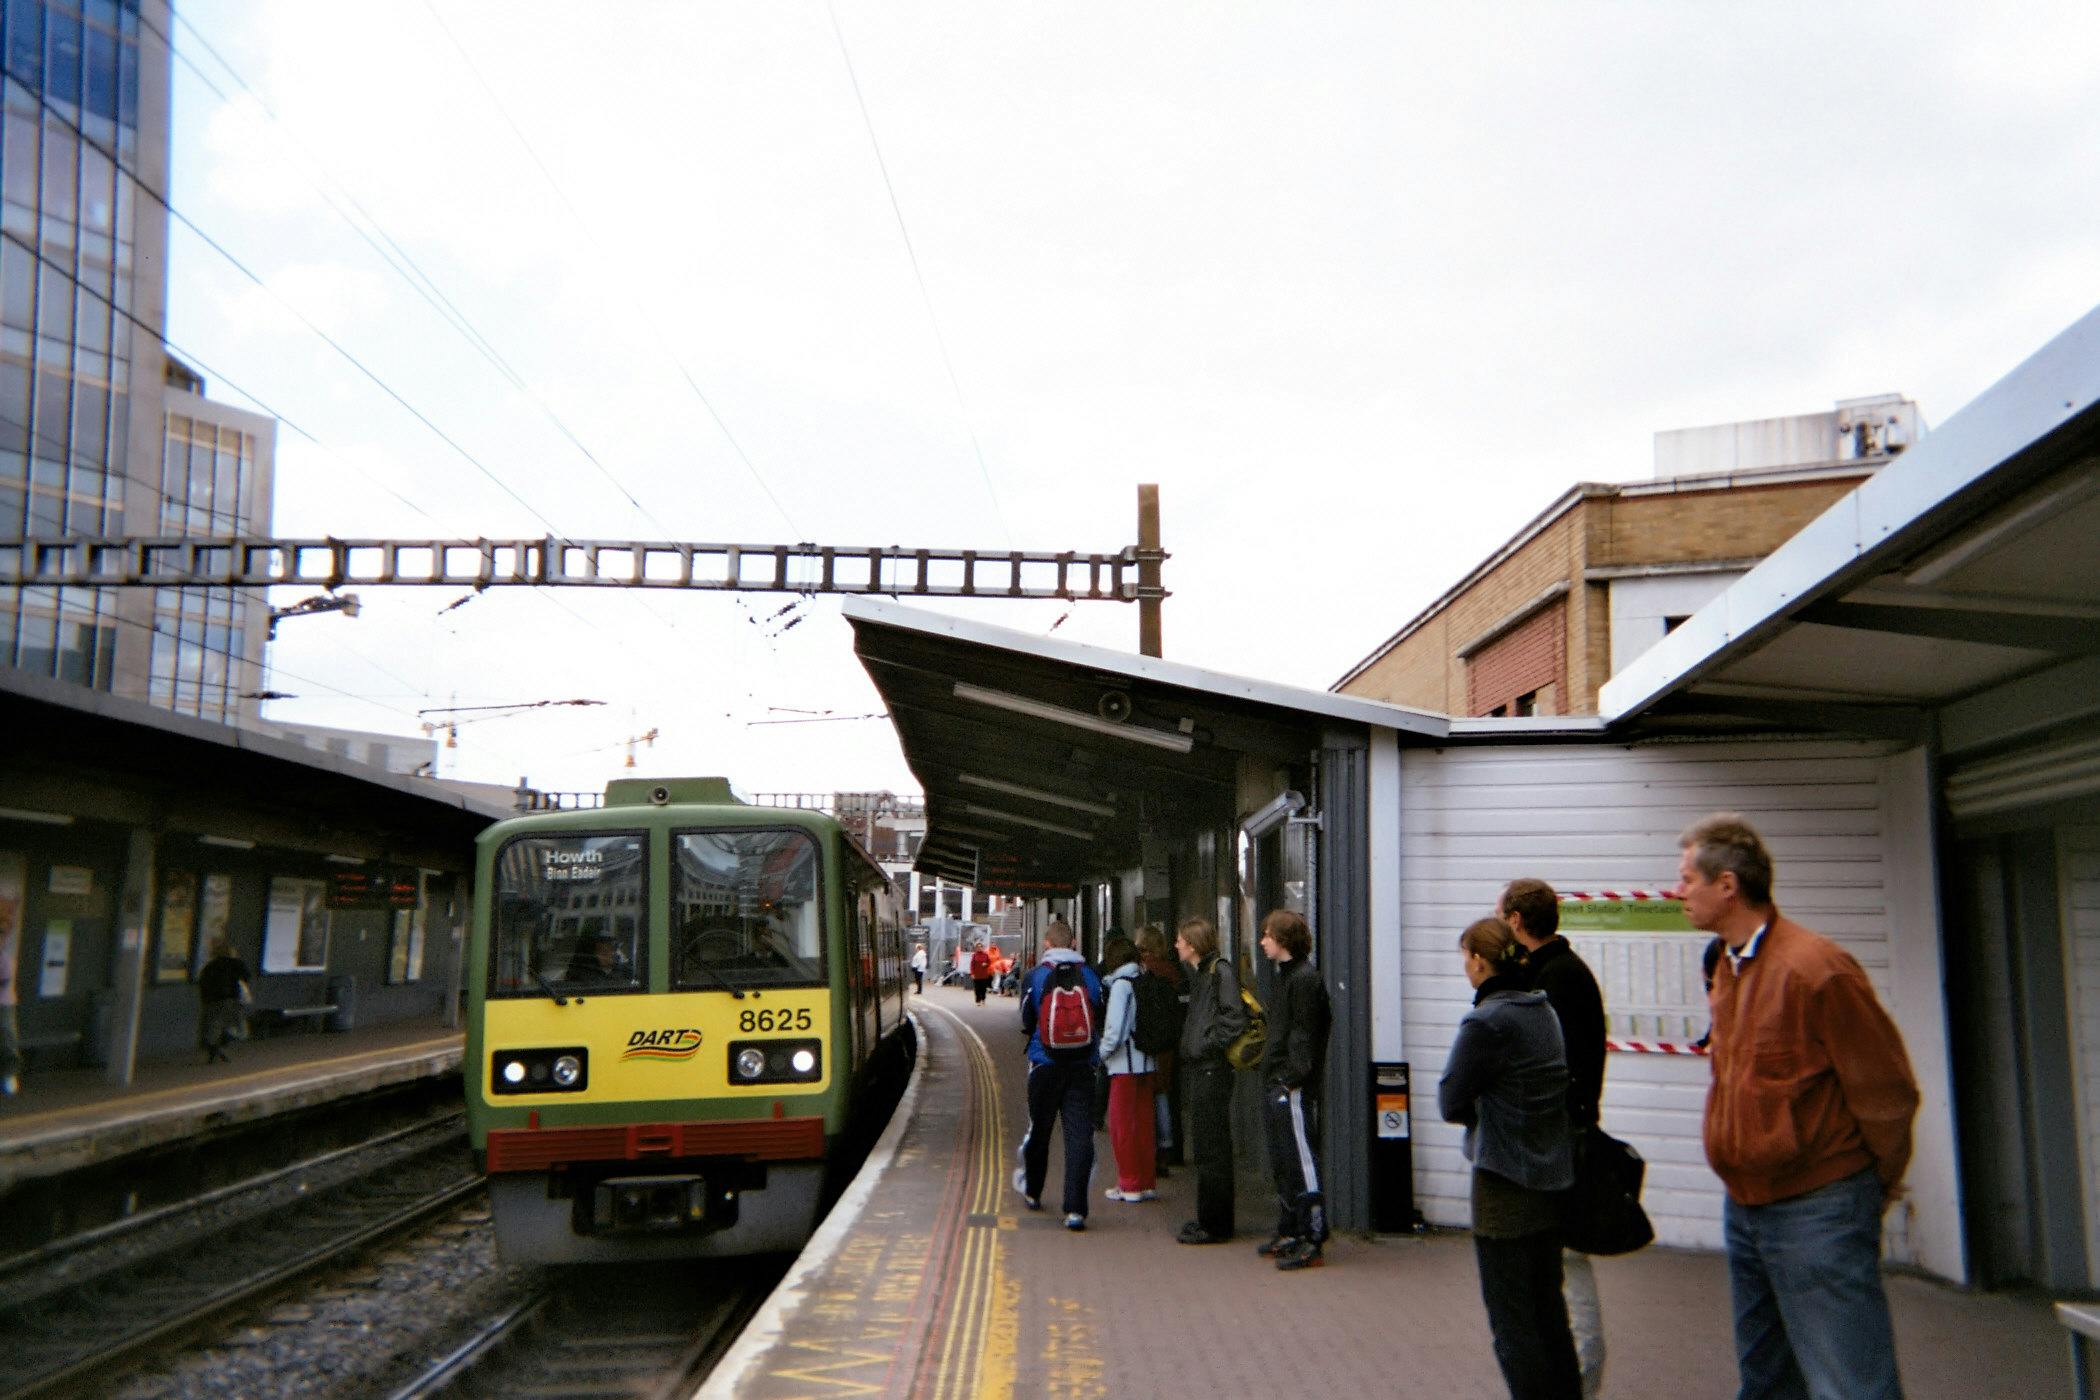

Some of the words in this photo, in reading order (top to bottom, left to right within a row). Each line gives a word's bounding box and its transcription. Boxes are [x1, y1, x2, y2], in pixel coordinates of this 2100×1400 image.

[545, 849, 602, 863] Howth
[740, 1009, 812, 1033] 8625
[628, 1030, 687, 1046] DART
